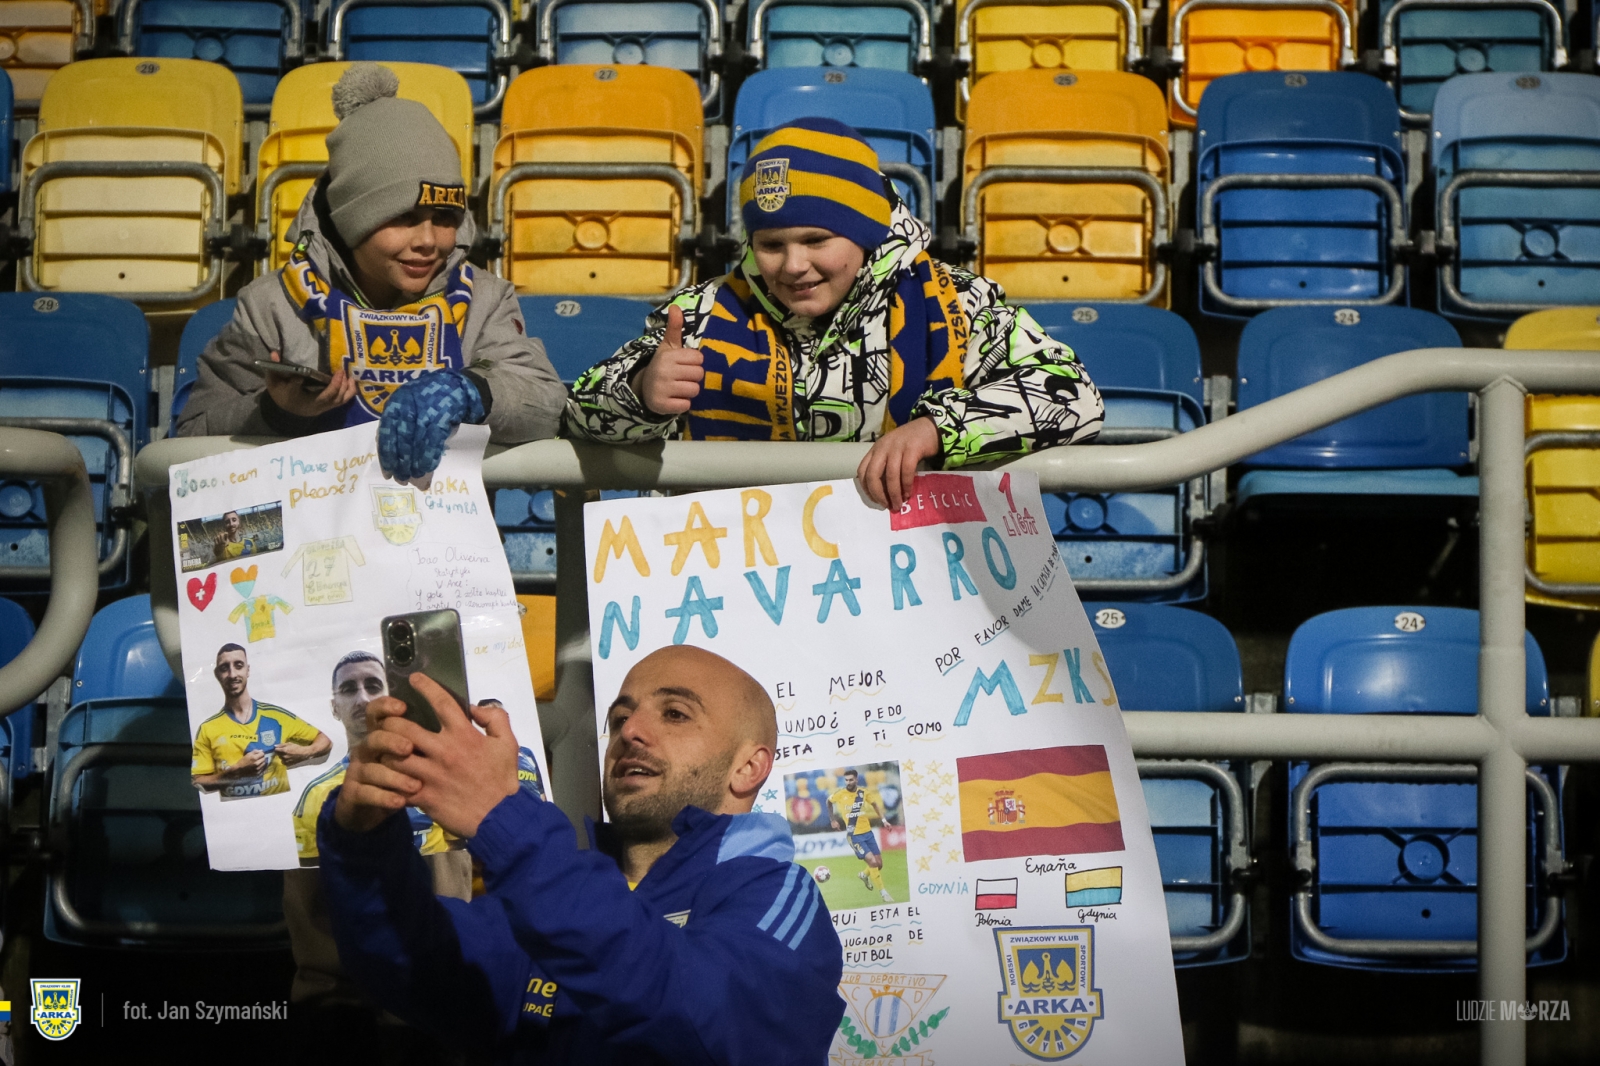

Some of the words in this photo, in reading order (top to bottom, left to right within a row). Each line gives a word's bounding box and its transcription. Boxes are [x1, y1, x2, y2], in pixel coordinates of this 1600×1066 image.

[599, 70, 613, 79] 27
[759, 186, 785, 195] ARKA
[38, 299, 54, 310] 29
[560, 303, 575, 315] 27
[359, 312, 407, 322] ZWIĄZKOWY
[409, 313, 430, 321] KLUB
[1077, 310, 1093, 321] 25
[1339, 312, 1355, 324] 24
[354, 329, 364, 359] MORSKI
[427, 322, 437, 364] SPORTOWY
[998, 472, 1017, 513] 1
[594, 484, 839, 583] MARC
[598, 526, 1017, 659] NAVARRO
[1102, 612, 1119, 625] 25
[1402, 617, 1418, 630] 24
[935, 647, 962, 673] POR
[974, 615, 1010, 644] FAVOR
[1012, 596, 1032, 617] DAME
[776, 681, 796, 698] EL
[829, 669, 886, 695] MEJOR
[953, 647, 1117, 726] MZKS
[864, 704, 902, 721] PEDO
[775, 743, 813, 760] SETA
[837, 735, 855, 749] DE
[907, 721, 942, 736] COMO
[226, 779, 279, 796] GDYNIA
[1025, 857, 1077, 876] España
[870, 907, 899, 922] ESTA
[908, 906, 920, 916] EL
[975, 912, 1013, 927] Polonia
[1077, 908, 1117, 923] Gdynia
[844, 934, 893, 948] JUGADOR
[908, 928, 924, 940] DE
[1006, 954, 1016, 985] MORSKI
[1013, 998, 1088, 1015] ARKA
